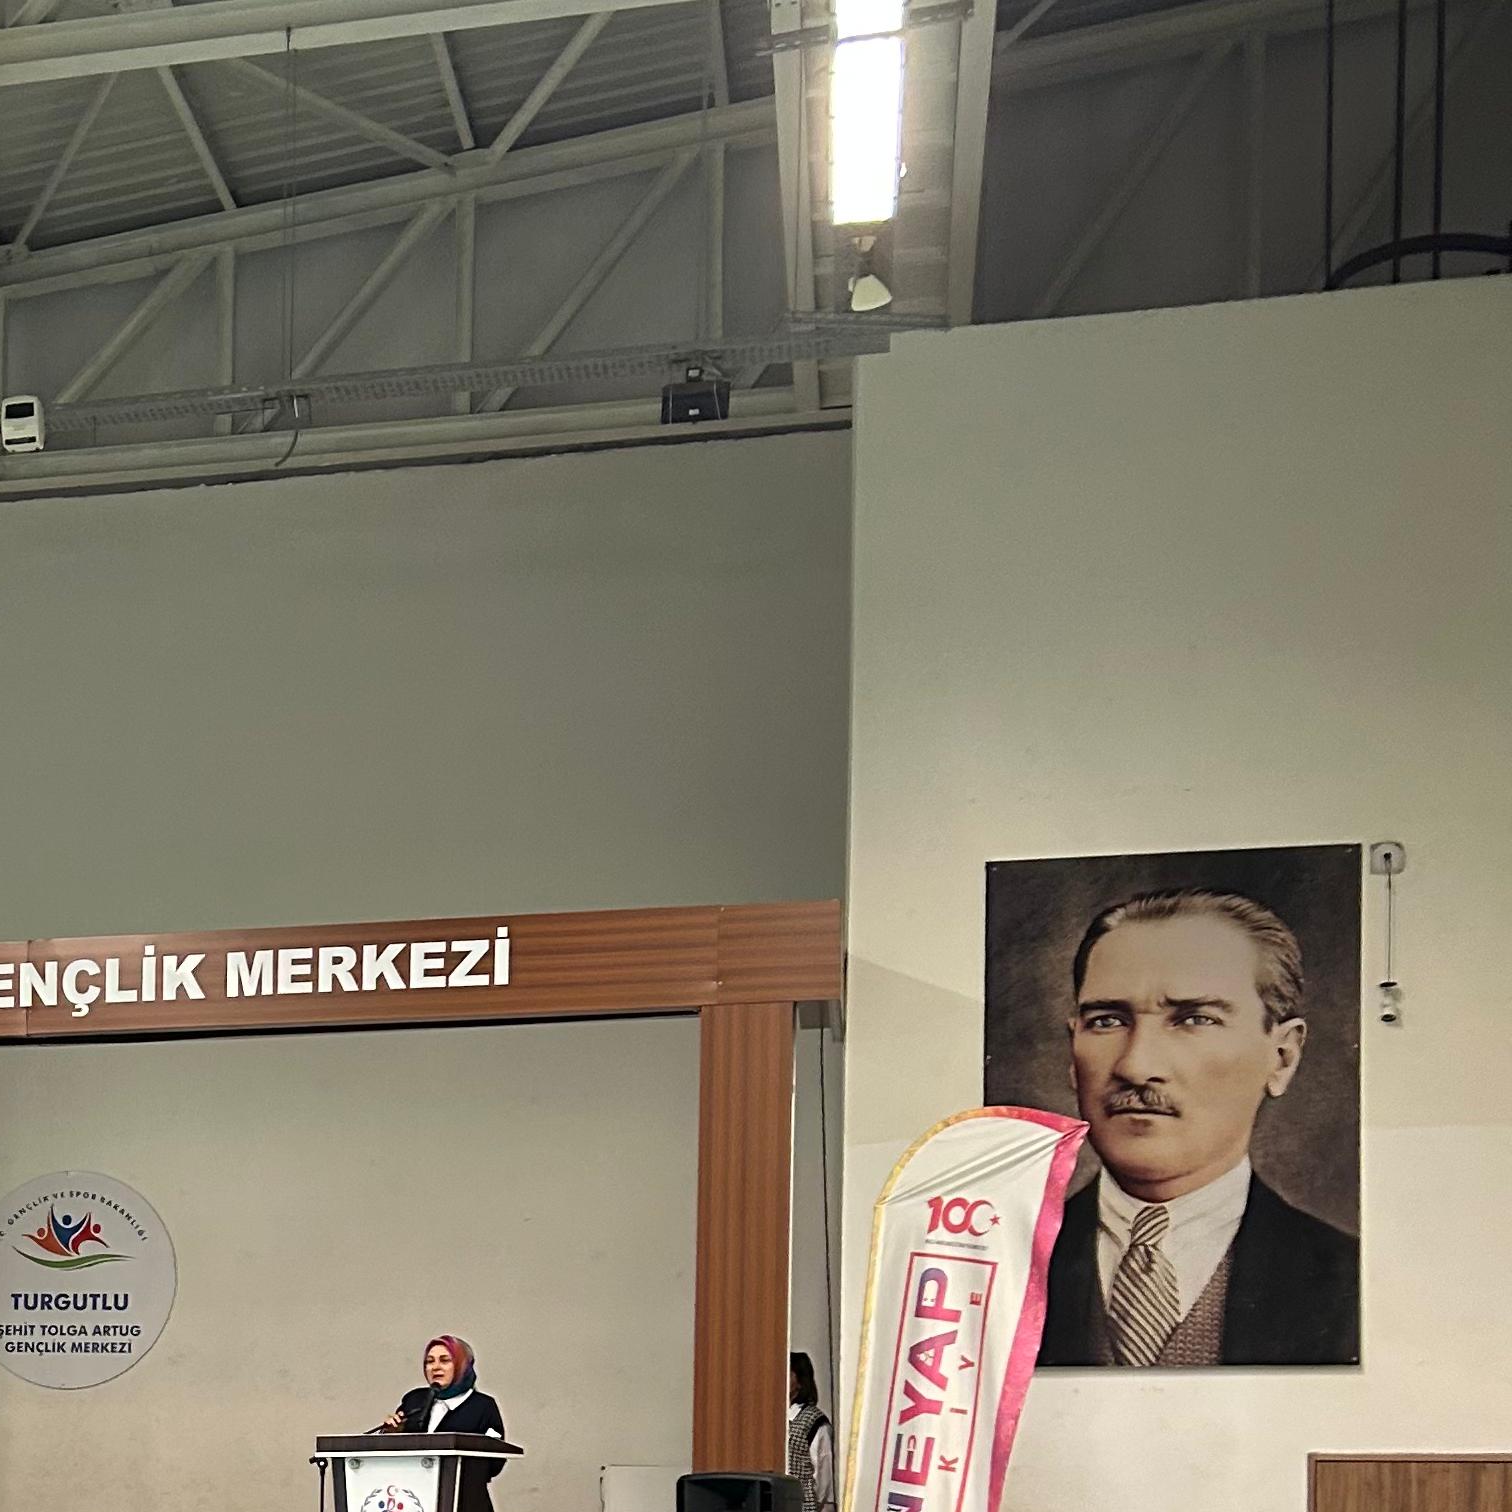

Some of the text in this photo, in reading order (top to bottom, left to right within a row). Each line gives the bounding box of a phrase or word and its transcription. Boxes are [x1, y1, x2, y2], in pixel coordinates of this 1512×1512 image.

[226, 926, 510, 998] MERKEZİ
[10, 1293, 129, 1311] TURGUTLU
[40, 1324, 88, 1337] TOLGA
[92, 1324, 142, 1337] ARTUG
[4, 1339, 133, 1356] GENÇLİK MERKEZİ
